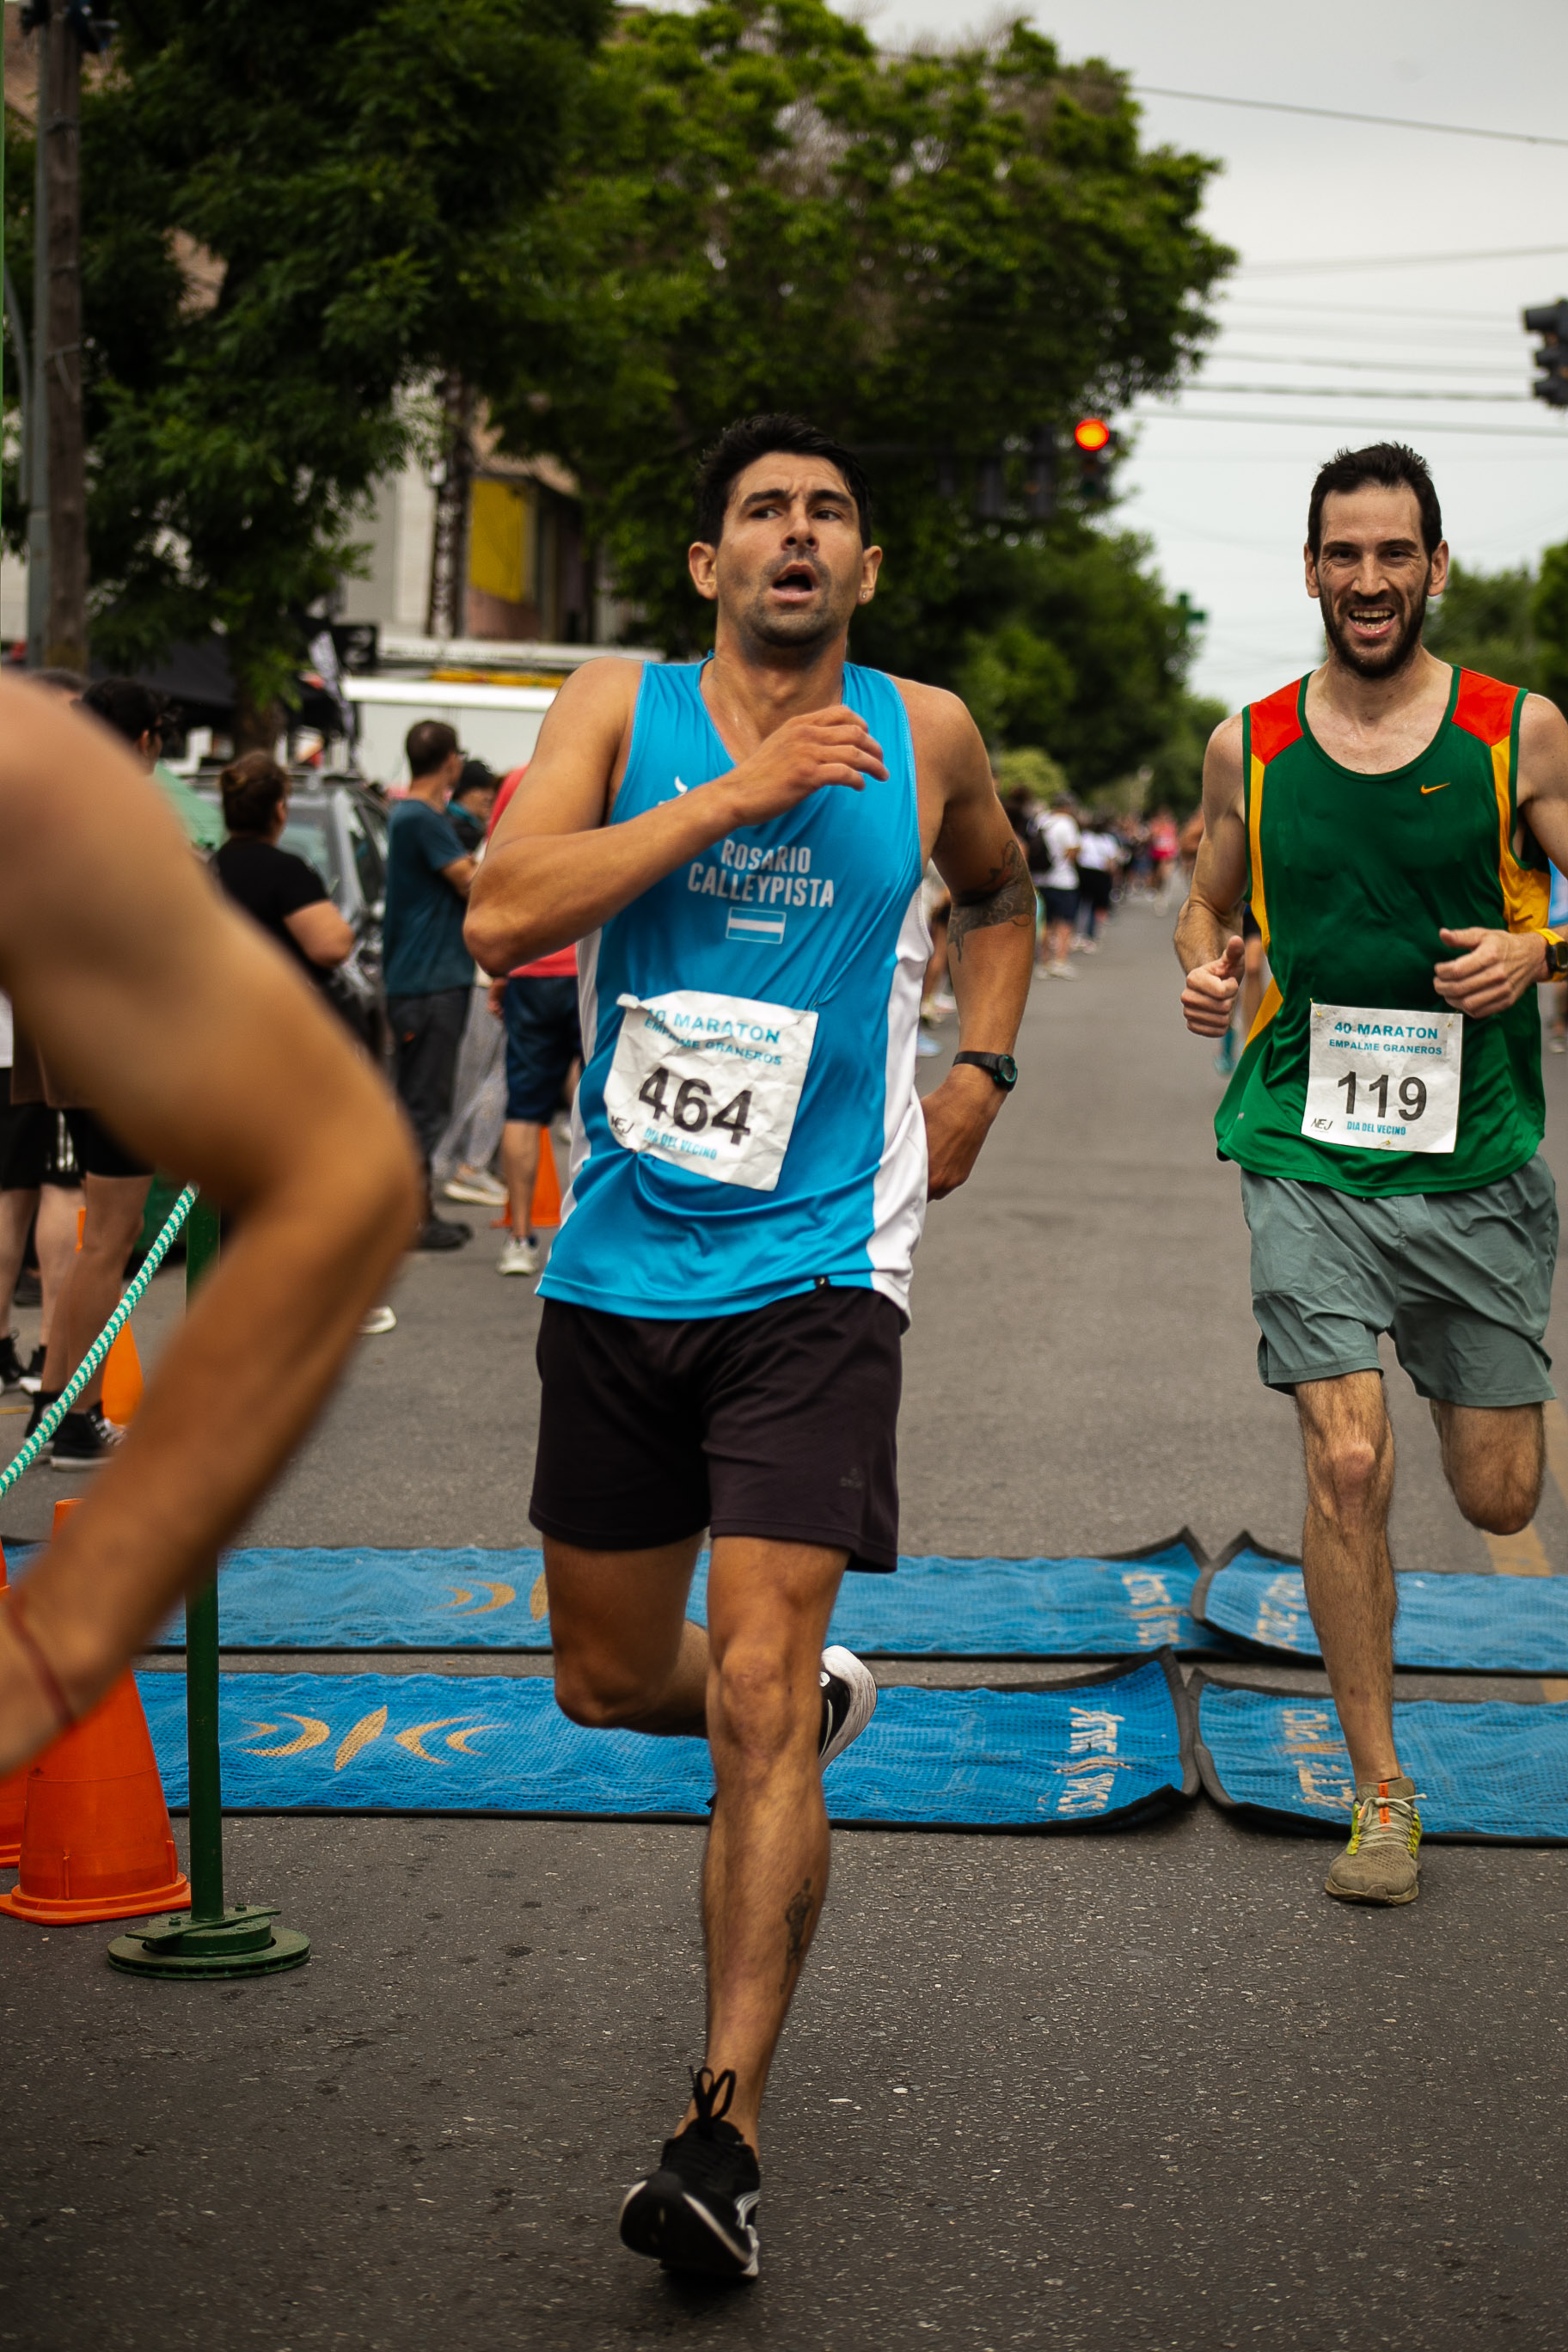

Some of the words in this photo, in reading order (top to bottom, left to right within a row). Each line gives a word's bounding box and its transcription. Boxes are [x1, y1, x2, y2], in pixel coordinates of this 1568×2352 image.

[720, 839, 812, 874] ROSARIO
[688, 862, 835, 909] CALLEYPISTA
[673, 1012, 781, 1044] MARATON
[1334, 1021, 1352, 1034] 40
[1357, 1023, 1438, 1040] MARATON
[705, 1040, 782, 1066] GRANEROS
[1329, 1038, 1380, 1052] EMPALME
[1383, 1044, 1442, 1056] GRANEROS
[639, 1067, 752, 1146] 464
[1337, 1070, 1427, 1122] 119
[1346, 1121, 1360, 1131] DIA
[1362, 1122, 1375, 1133] DEL
[1376, 1124, 1406, 1136] VECINO
[680, 1139, 718, 1161] VECINO
